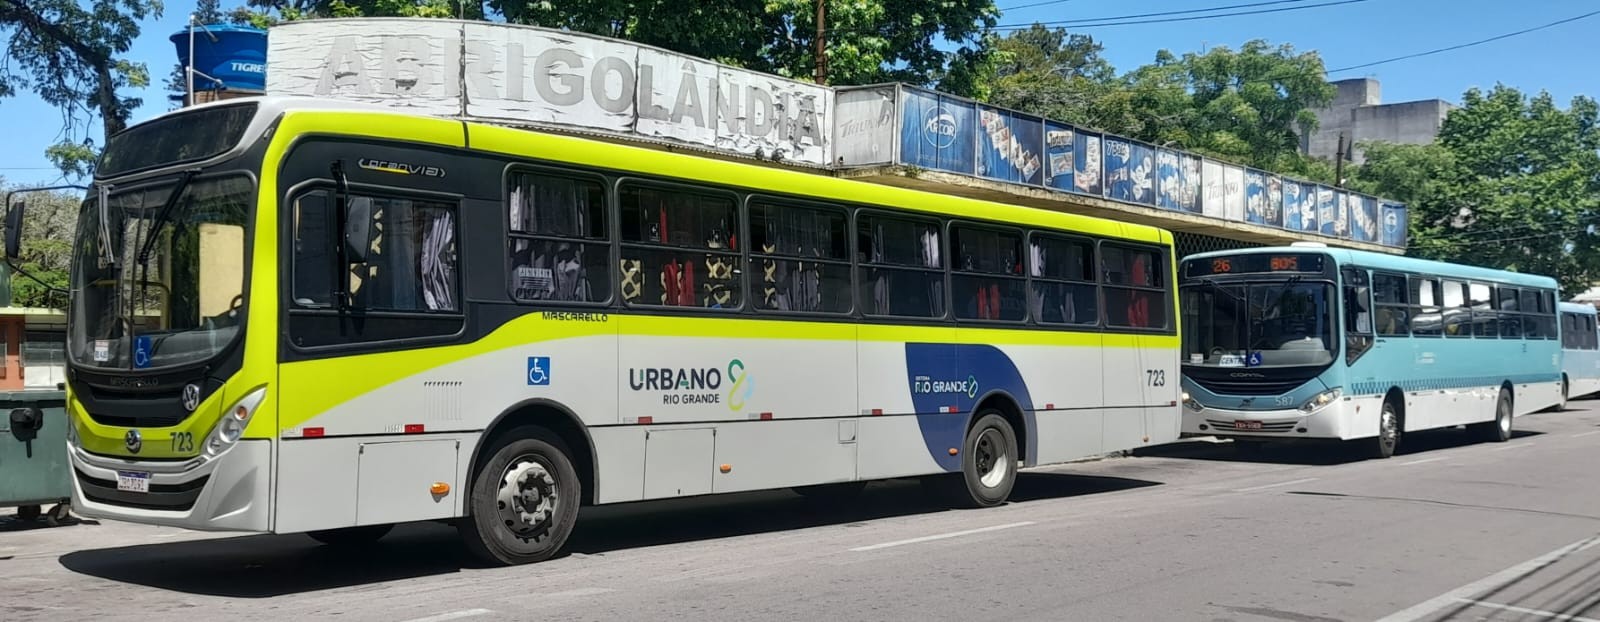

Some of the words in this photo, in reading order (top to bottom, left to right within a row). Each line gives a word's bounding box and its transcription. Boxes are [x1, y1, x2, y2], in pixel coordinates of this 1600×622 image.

[231, 62, 265, 73] TIGRE
[313, 36, 823, 147] ABRIGOLÂNDIA
[925, 117, 955, 137] ARCOR
[1213, 259, 1231, 273] 26
[541, 311, 608, 322] MASCARELLO
[629, 367, 722, 391] URBANO
[1146, 369, 1165, 387] 723
[915, 381, 931, 393] RIO
[932, 380, 968, 393] GRANDE
[663, 394, 680, 405] RIO
[682, 393, 720, 405] GRANDE
[1275, 396, 1294, 406] 587
[169, 431, 194, 453] 723
